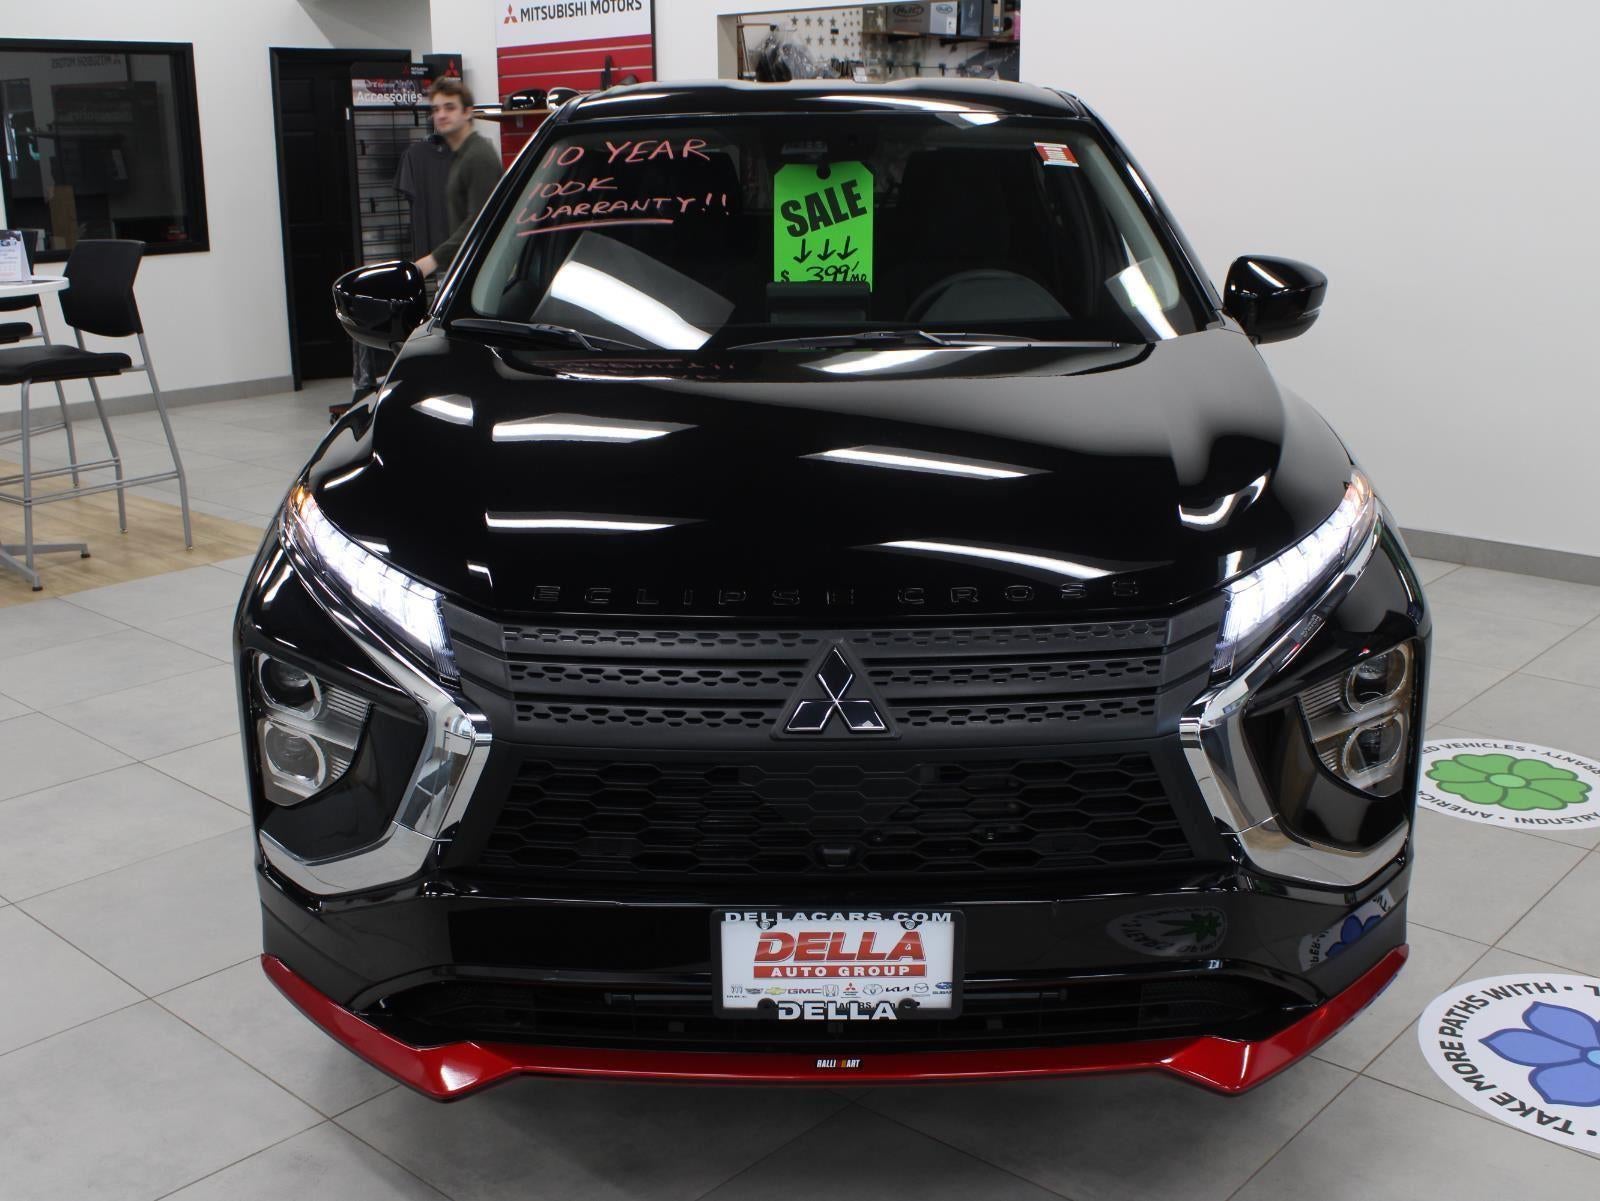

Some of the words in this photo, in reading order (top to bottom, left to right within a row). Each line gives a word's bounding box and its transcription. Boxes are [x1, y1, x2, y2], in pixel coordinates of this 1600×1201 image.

[520, 1, 588, 23] MITSUBISHI
[590, 0, 643, 15] MOTORS
[357, 91, 423, 104] Accessories
[542, 147, 585, 169] 10
[606, 138, 711, 164] YEAR
[527, 177, 618, 200] 100K
[781, 180, 868, 239] SALE
[896, 579, 1139, 604] CROSS
[1440, 742, 1526, 752] VEHICLES
[725, 912, 952, 923] DELLACARS.COM
[753, 931, 926, 962] DELLA
[771, 966, 828, 978] AUTO
[838, 965, 911, 977] GROUP
[1482, 982, 1557, 1001] WITH
[778, 1001, 898, 1020] DELLA
[1438, 994, 1490, 1038] PATHS
[1439, 1040, 1498, 1092] MORE
[1489, 1091, 1575, 1136] TAKE
